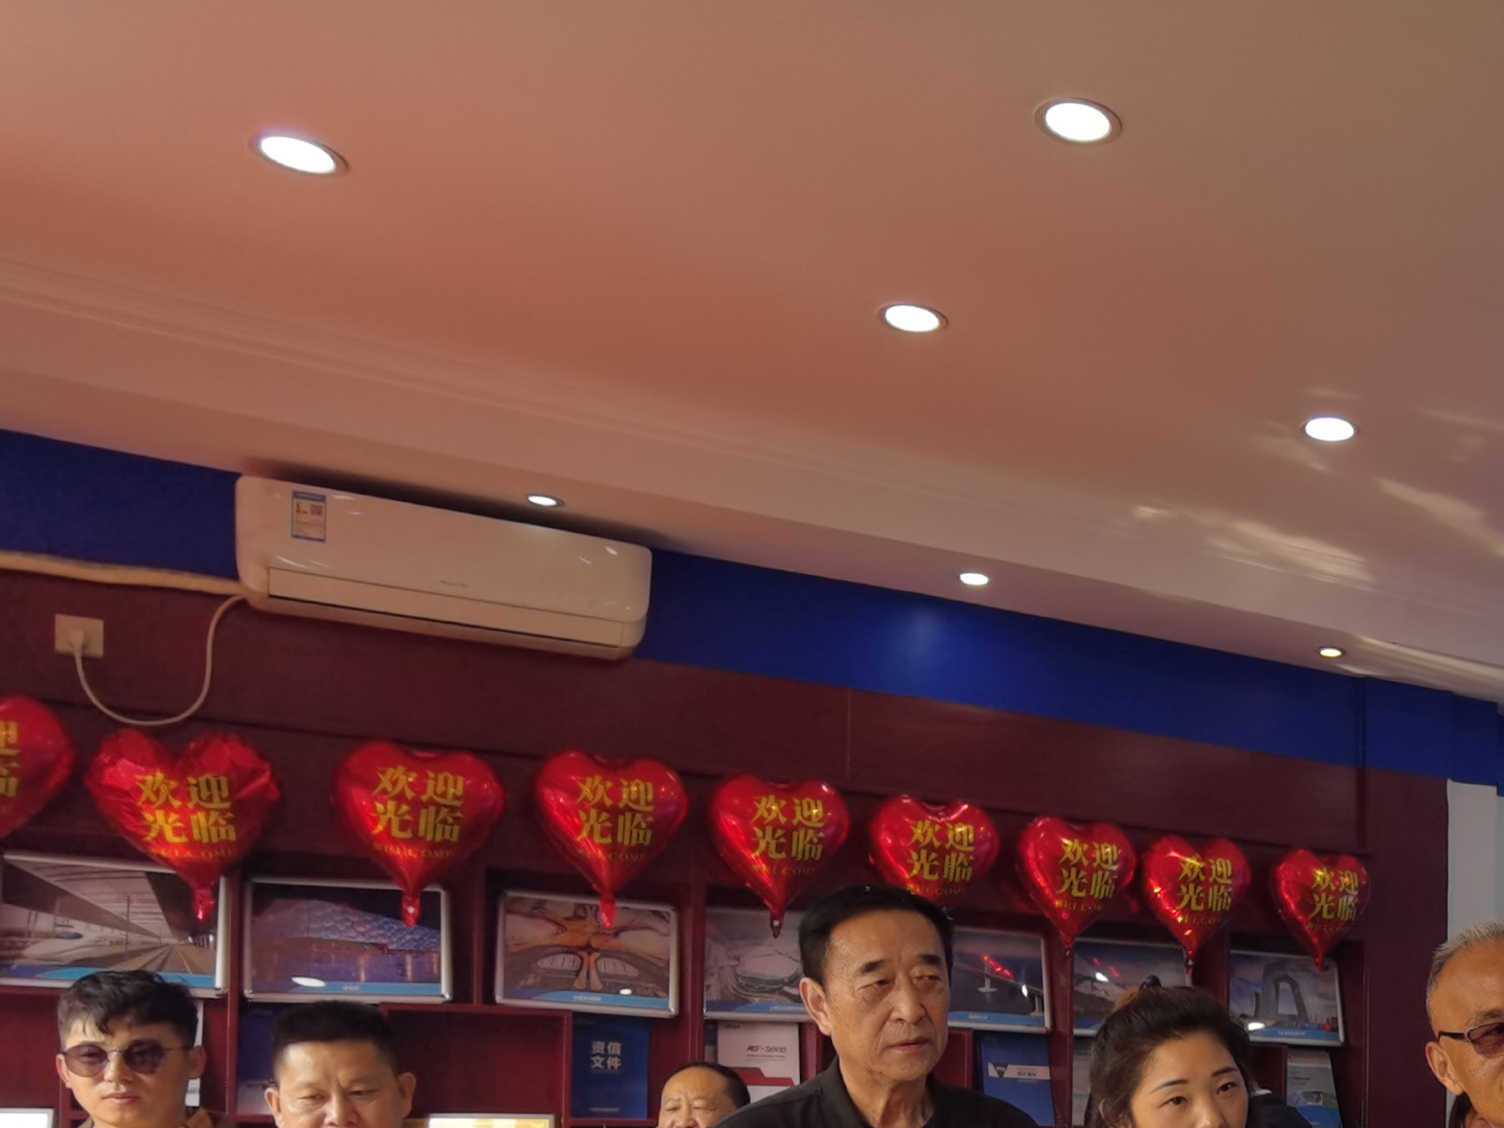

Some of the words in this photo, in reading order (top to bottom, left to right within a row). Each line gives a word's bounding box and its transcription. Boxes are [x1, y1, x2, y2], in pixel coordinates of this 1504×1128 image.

[135, 771, 231, 809] 欢迎
[371, 765, 466, 807] 欢迎
[574, 775, 655, 813] 欢迎
[143, 811, 236, 843] 光临
[371, 800, 463, 843] 光临
[750, 795, 826, 828] 欢迎
[576, 809, 655, 847] 光临
[751, 826, 826, 861] 光临
[909, 820, 976, 852] 欢迎
[908, 849, 974, 883] 光临
[1058, 838, 1120, 870] 欢迎
[1178, 855, 1234, 885] 欢迎
[1056, 867, 1117, 899] 光临
[1310, 866, 1359, 895] 欢迎
[1176, 883, 1233, 912] 光临
[1308, 892, 1358, 921] 光临
[591, 1056, 622, 1071] 文件
